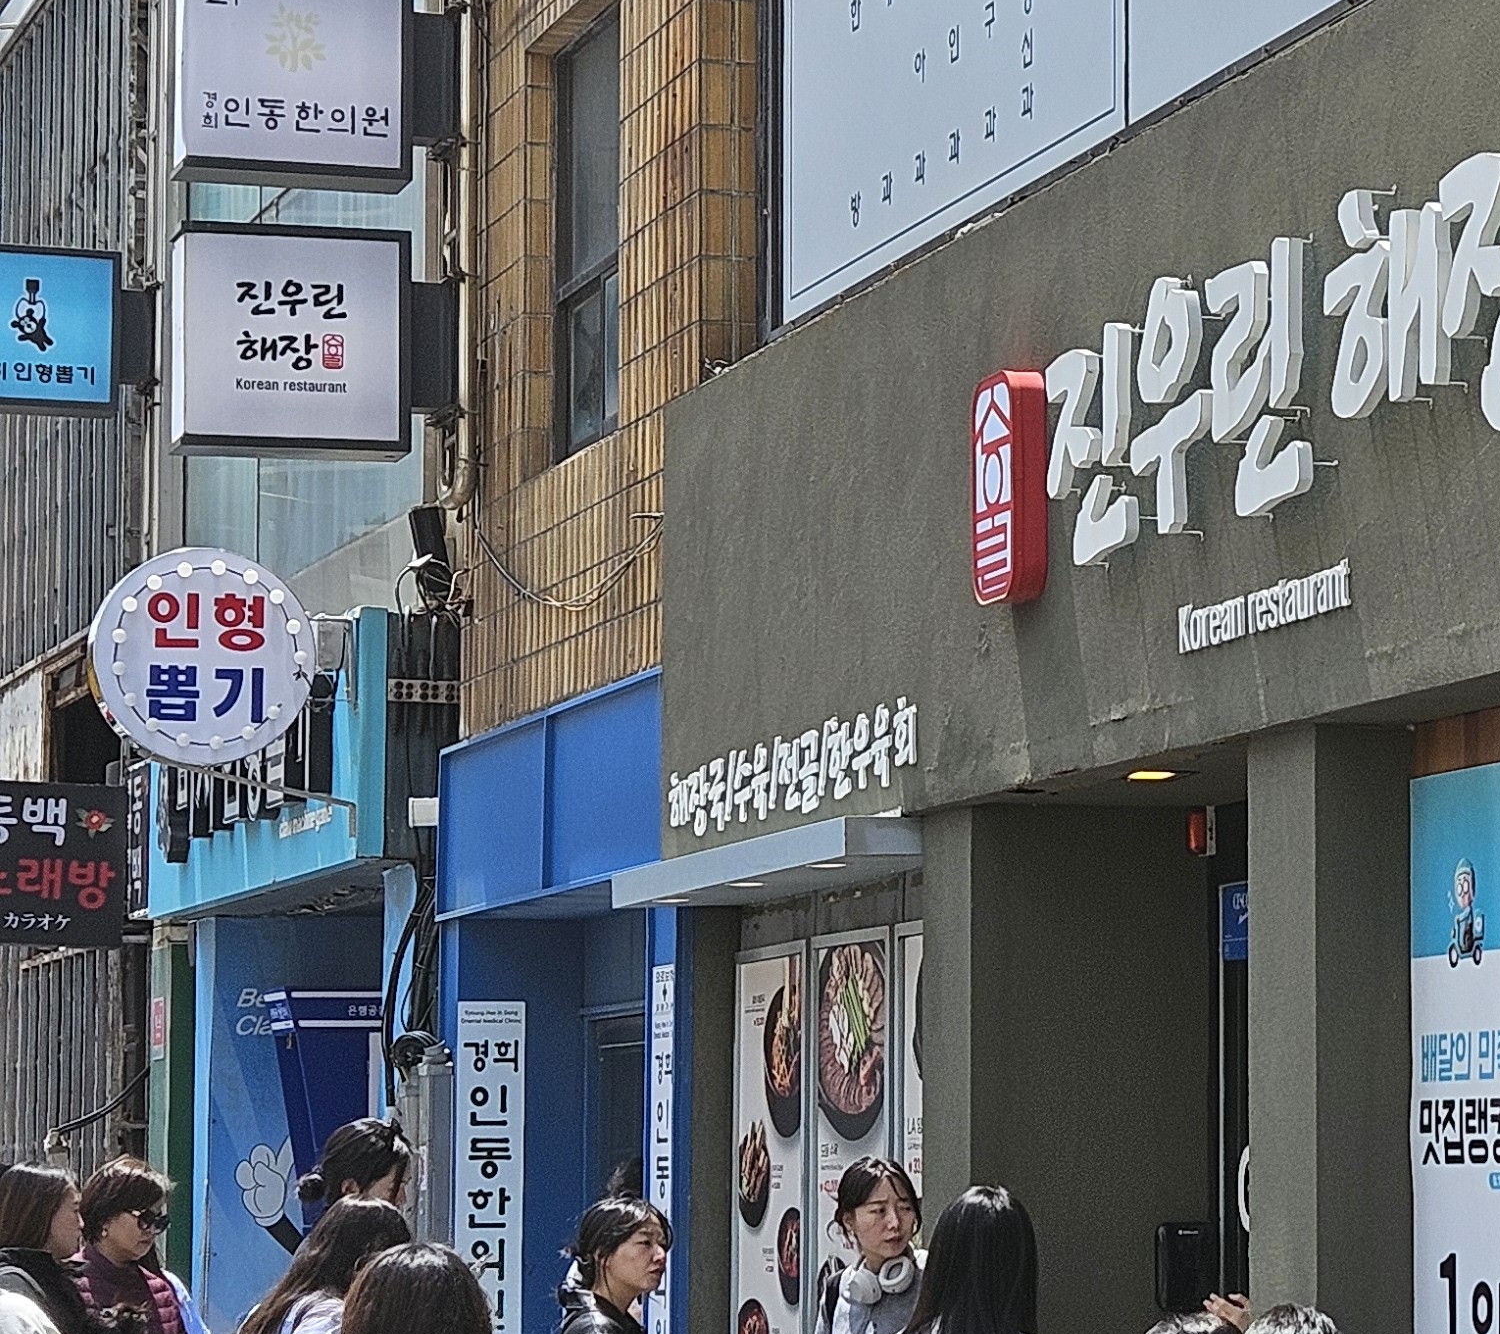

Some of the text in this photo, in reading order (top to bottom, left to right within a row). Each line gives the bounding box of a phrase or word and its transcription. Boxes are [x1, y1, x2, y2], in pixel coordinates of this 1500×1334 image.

[235, 279, 348, 320] 진우린
[235, 330, 319, 371] 해장
[13, 362, 95, 386] 인형뽑기
[235, 377, 347, 394] Korean restaurant
[1046, 237, 1314, 567] 진우린
[146, 592, 266, 652] 인형
[1177, 557, 1352, 654] Korean restaurant
[145, 664, 265, 724] 뽑기
[0, 858, 117, 910] 래방
[3, 911, 72, 932] カラオケ
[463, 1039, 520, 1073] 경희
[1421, 1031, 1472, 1083] 배달의
